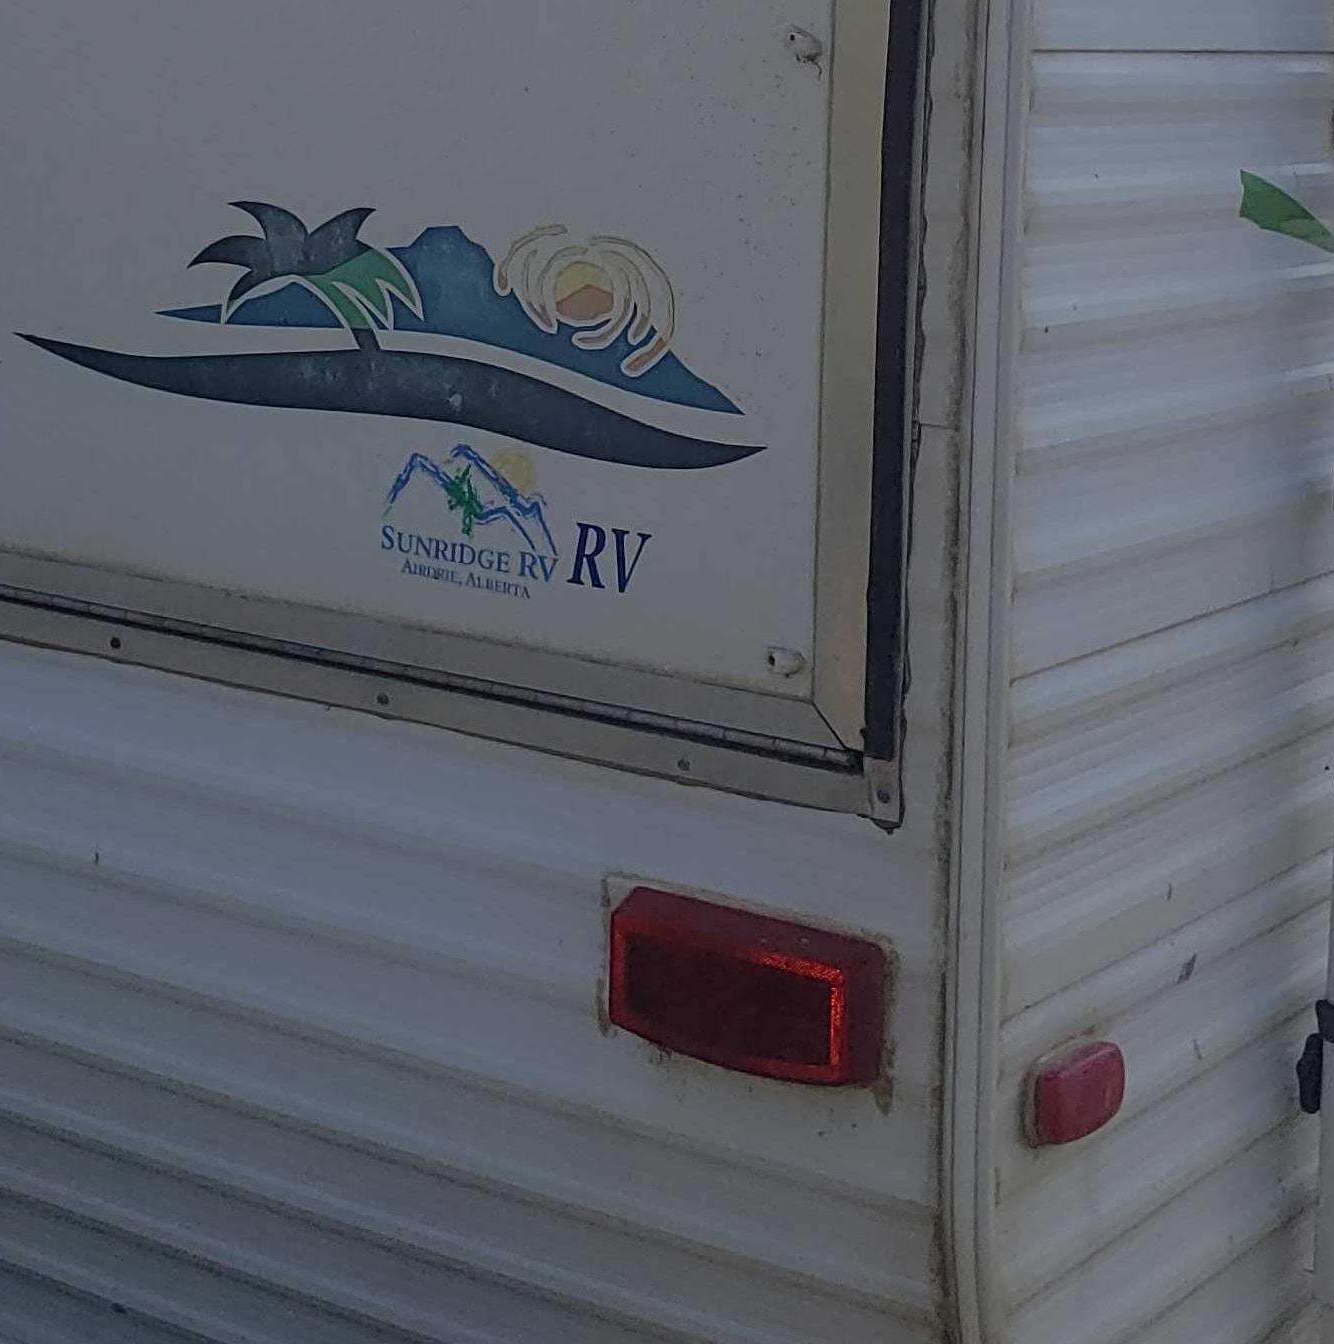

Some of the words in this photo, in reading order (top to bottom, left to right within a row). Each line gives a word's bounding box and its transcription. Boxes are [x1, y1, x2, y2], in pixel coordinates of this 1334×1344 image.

[380, 525, 511, 574] SUNRIDGE
[518, 550, 560, 583] RV
[567, 522, 652, 594] RV
[466, 572, 531, 600] ALBERTA
